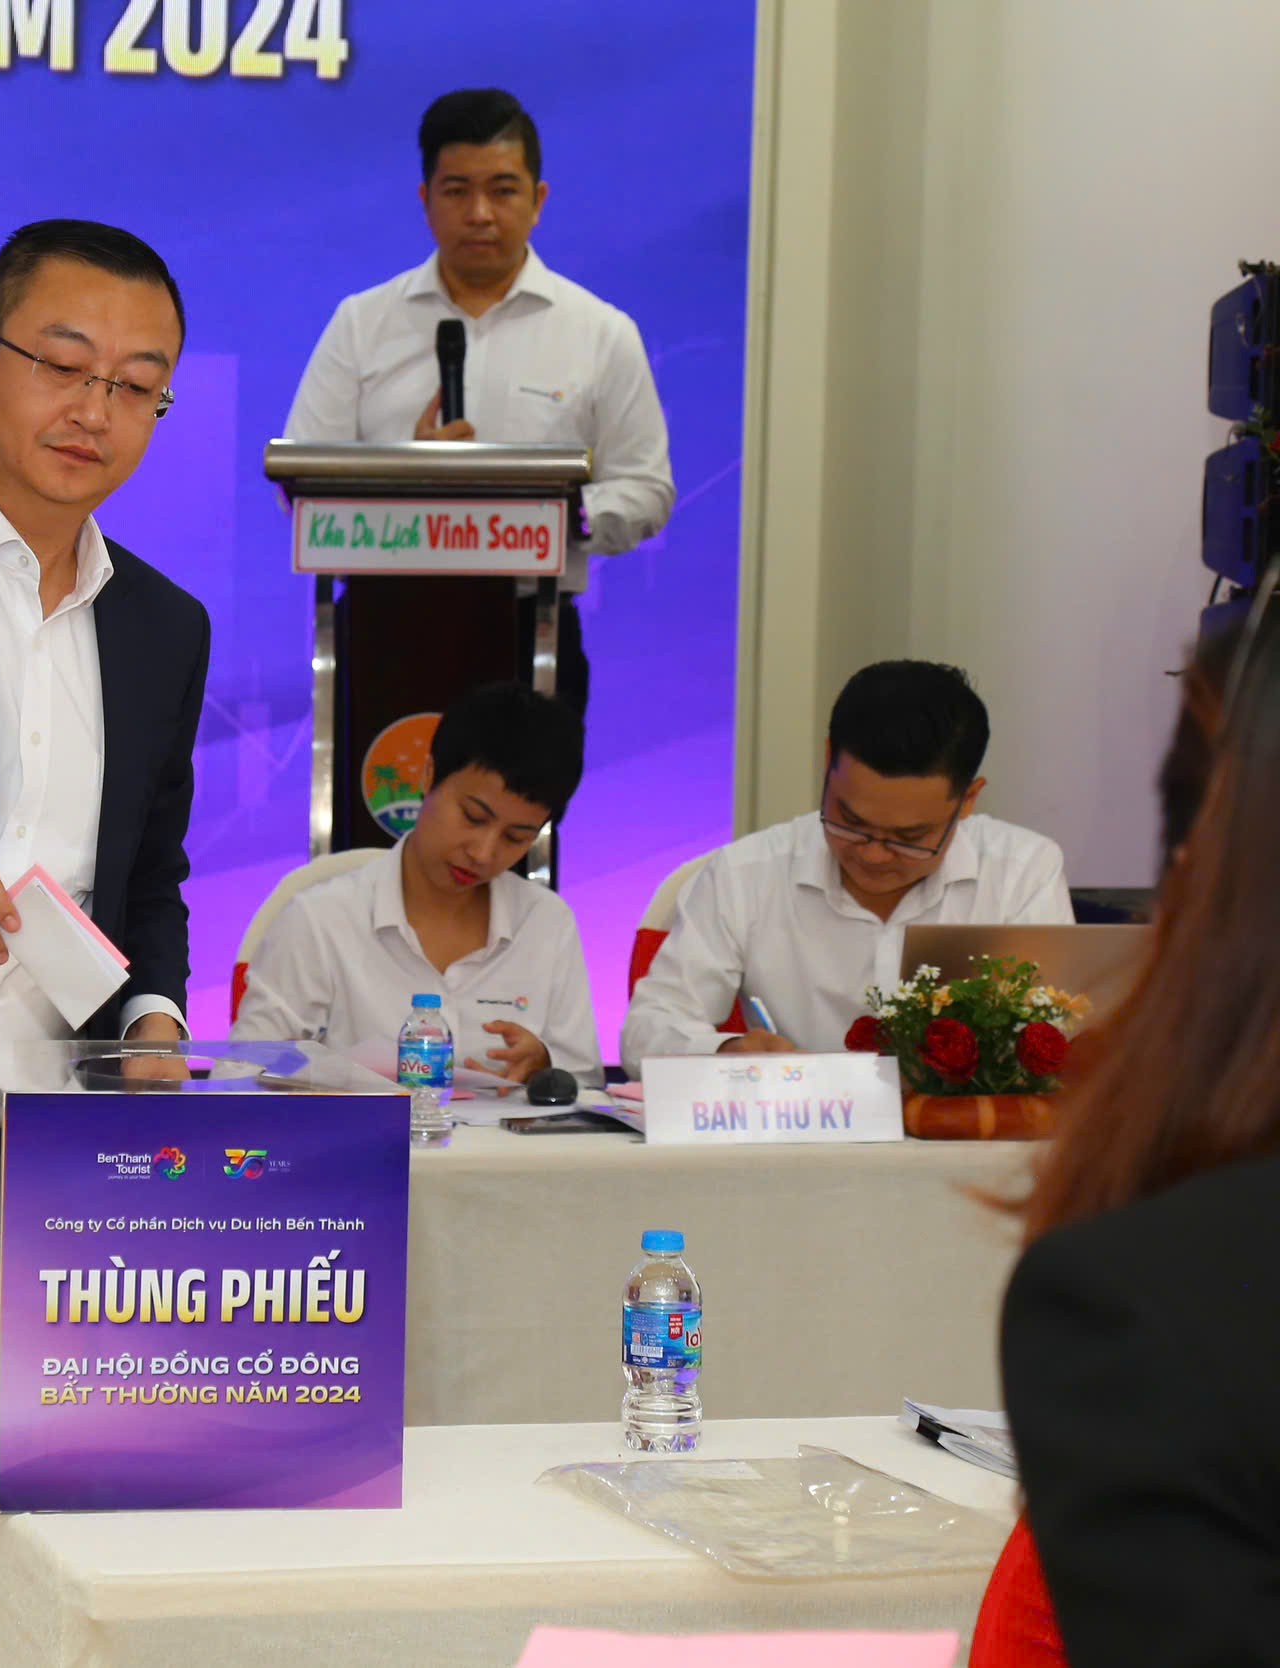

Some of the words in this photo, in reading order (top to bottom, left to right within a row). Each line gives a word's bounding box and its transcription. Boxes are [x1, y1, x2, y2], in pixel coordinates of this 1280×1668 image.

[103, 0, 349, 79] 2024
[351, 512, 375, 548] Du
[426, 513, 480, 550] Vinh
[487, 513, 551, 561] Sang
[400, 1058, 432, 1075] aVie
[692, 1099, 748, 1132] BAN
[97, 1153, 152, 1164] BenThanh
[115, 1164, 151, 1175] Tourist
[44, 1216, 84, 1233] Công
[87, 1218, 103, 1233] ty
[171, 1217, 205, 1233] Dịch
[208, 1220, 226, 1233] vụ
[231, 1218, 252, 1230] Du
[256, 1217, 282, 1233] lịch
[286, 1216, 315, 1230] Bến
[318, 1217, 365, 1230] Thành
[39, 1255, 207, 1323] THÙNG
[221, 1249, 366, 1324] PHIẾU
[41, 1357, 88, 1380] ĐẠI
[95, 1352, 143, 1380] HỘI
[149, 1350, 230, 1375] ĐỒNG
[236, 1348, 274, 1375] CỔ
[280, 1352, 361, 1375] ĐÔNG
[40, 1379, 94, 1405] BẤT
[100, 1382, 219, 1404] THƯỜNG
[226, 1380, 289, 1404] NĂM
[295, 1386, 362, 1404] 2024
